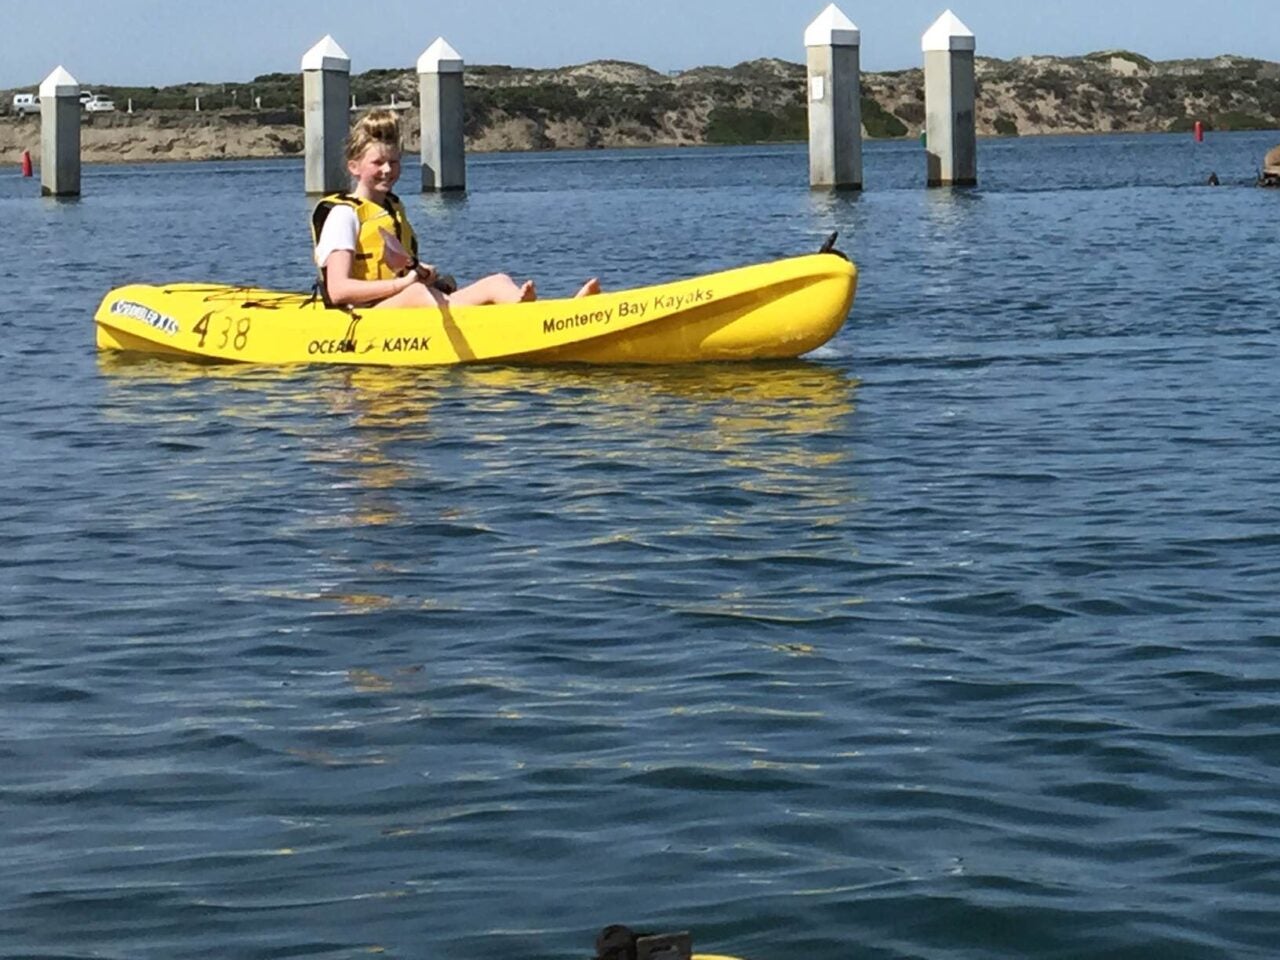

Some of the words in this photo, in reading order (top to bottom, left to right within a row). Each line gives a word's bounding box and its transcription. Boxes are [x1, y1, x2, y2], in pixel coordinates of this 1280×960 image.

[542, 308, 613, 334] Monterey
[618, 301, 648, 317] Bay
[653, 288, 714, 310] Kayaks
[382, 336, 431, 352] KAYAK
